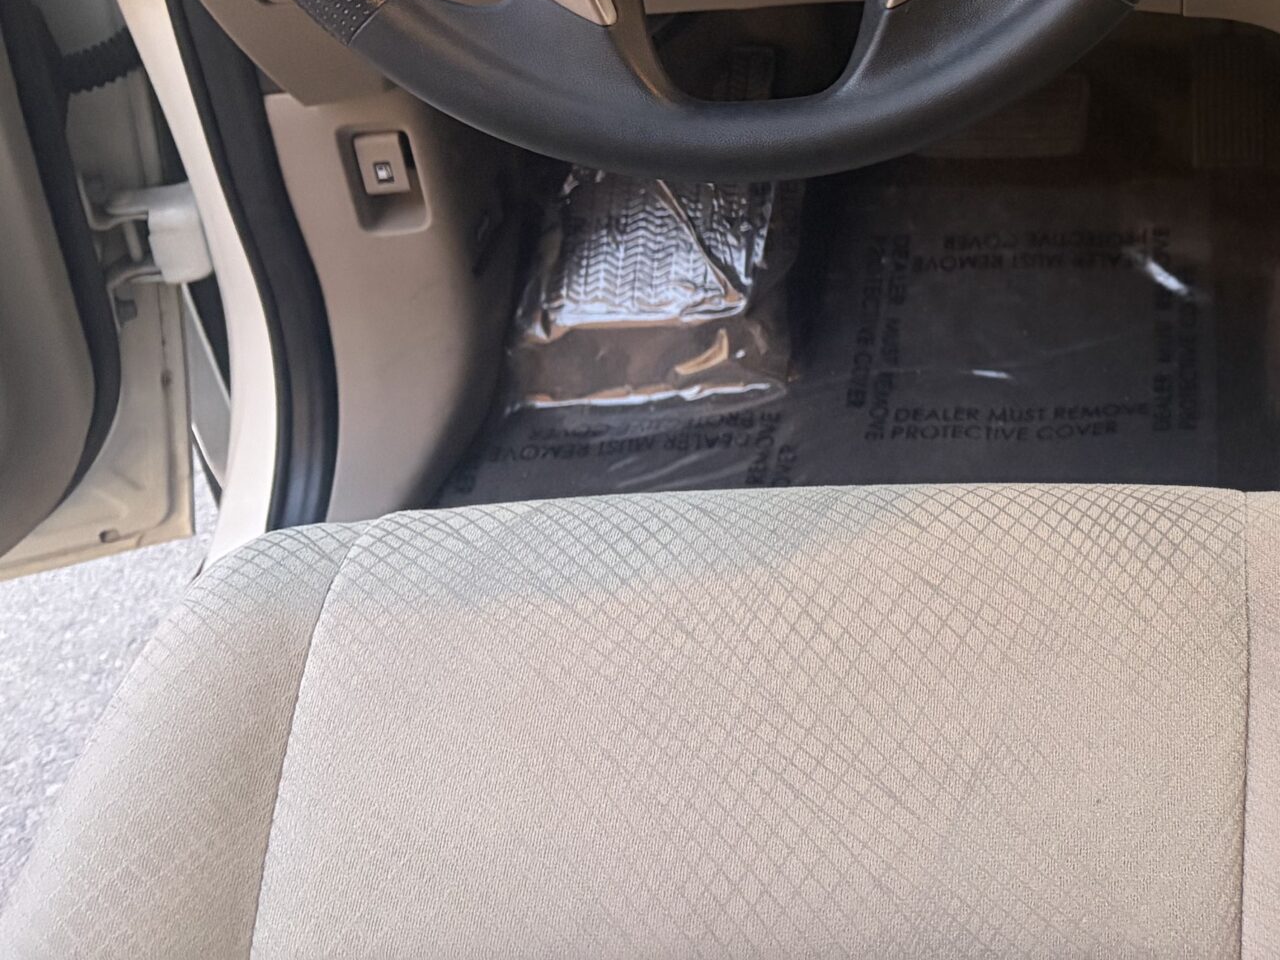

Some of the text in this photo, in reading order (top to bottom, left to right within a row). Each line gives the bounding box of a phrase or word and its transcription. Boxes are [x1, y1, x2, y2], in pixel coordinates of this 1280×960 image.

[893, 401, 1149, 424] DEALER MUST REMOVE
[890, 419, 1117, 442] PROTECTIVE COVER
